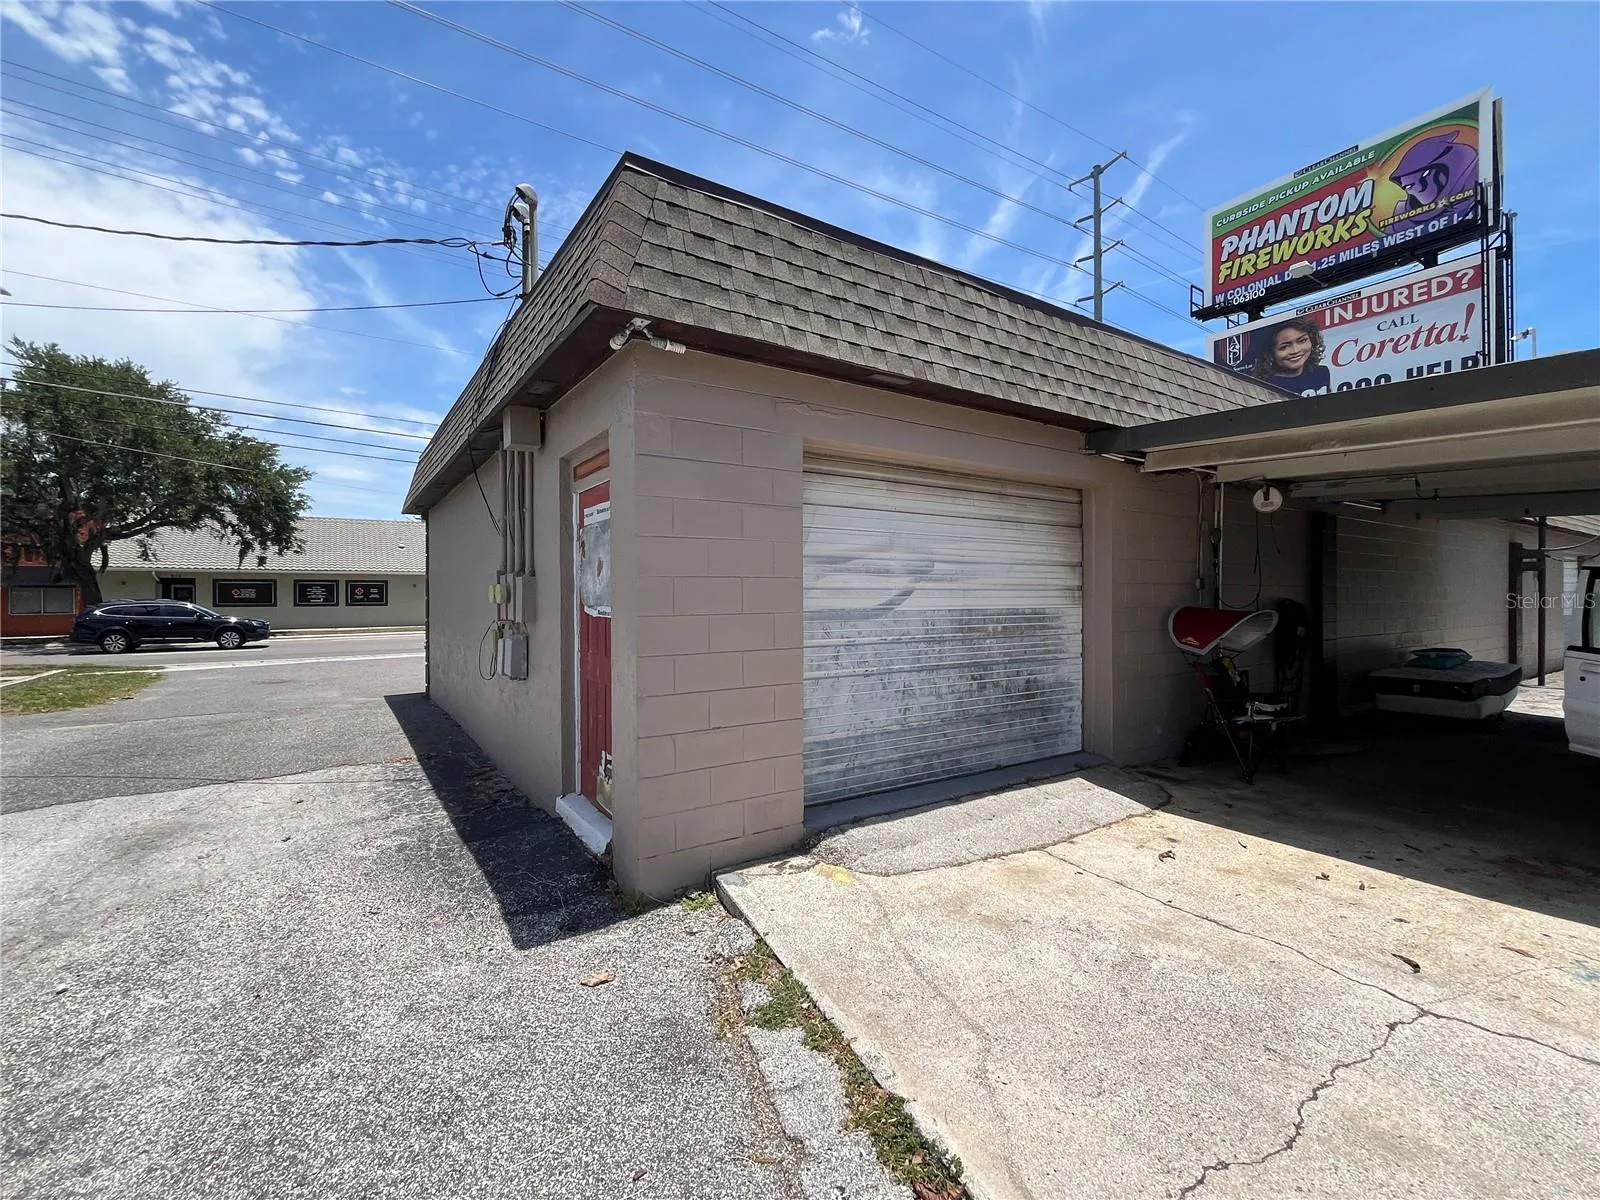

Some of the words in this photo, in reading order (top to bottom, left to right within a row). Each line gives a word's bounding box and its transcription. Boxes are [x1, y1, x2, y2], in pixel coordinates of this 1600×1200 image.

[1216, 200, 1266, 227] CURBSIDE
[1268, 181, 1309, 205] PICKUP
[1312, 150, 1375, 185] AVAILABLE
[1220, 179, 1375, 262] PHANTOM
[1215, 292, 1225, 304] W
[1227, 275, 1282, 300] COLONIAL
[1339, 240, 1379, 263] MILES
[1382, 224, 1424, 248] WEST
[1428, 216, 1449, 233] OF
[1218, 208, 1371, 285] FIREWORKS
[1233, 288, 1266, 305] 063100
[1325, 268, 1475, 327] INJURED?
[1377, 313, 1420, 332] CALL
[1331, 302, 1476, 367] Coretta!
